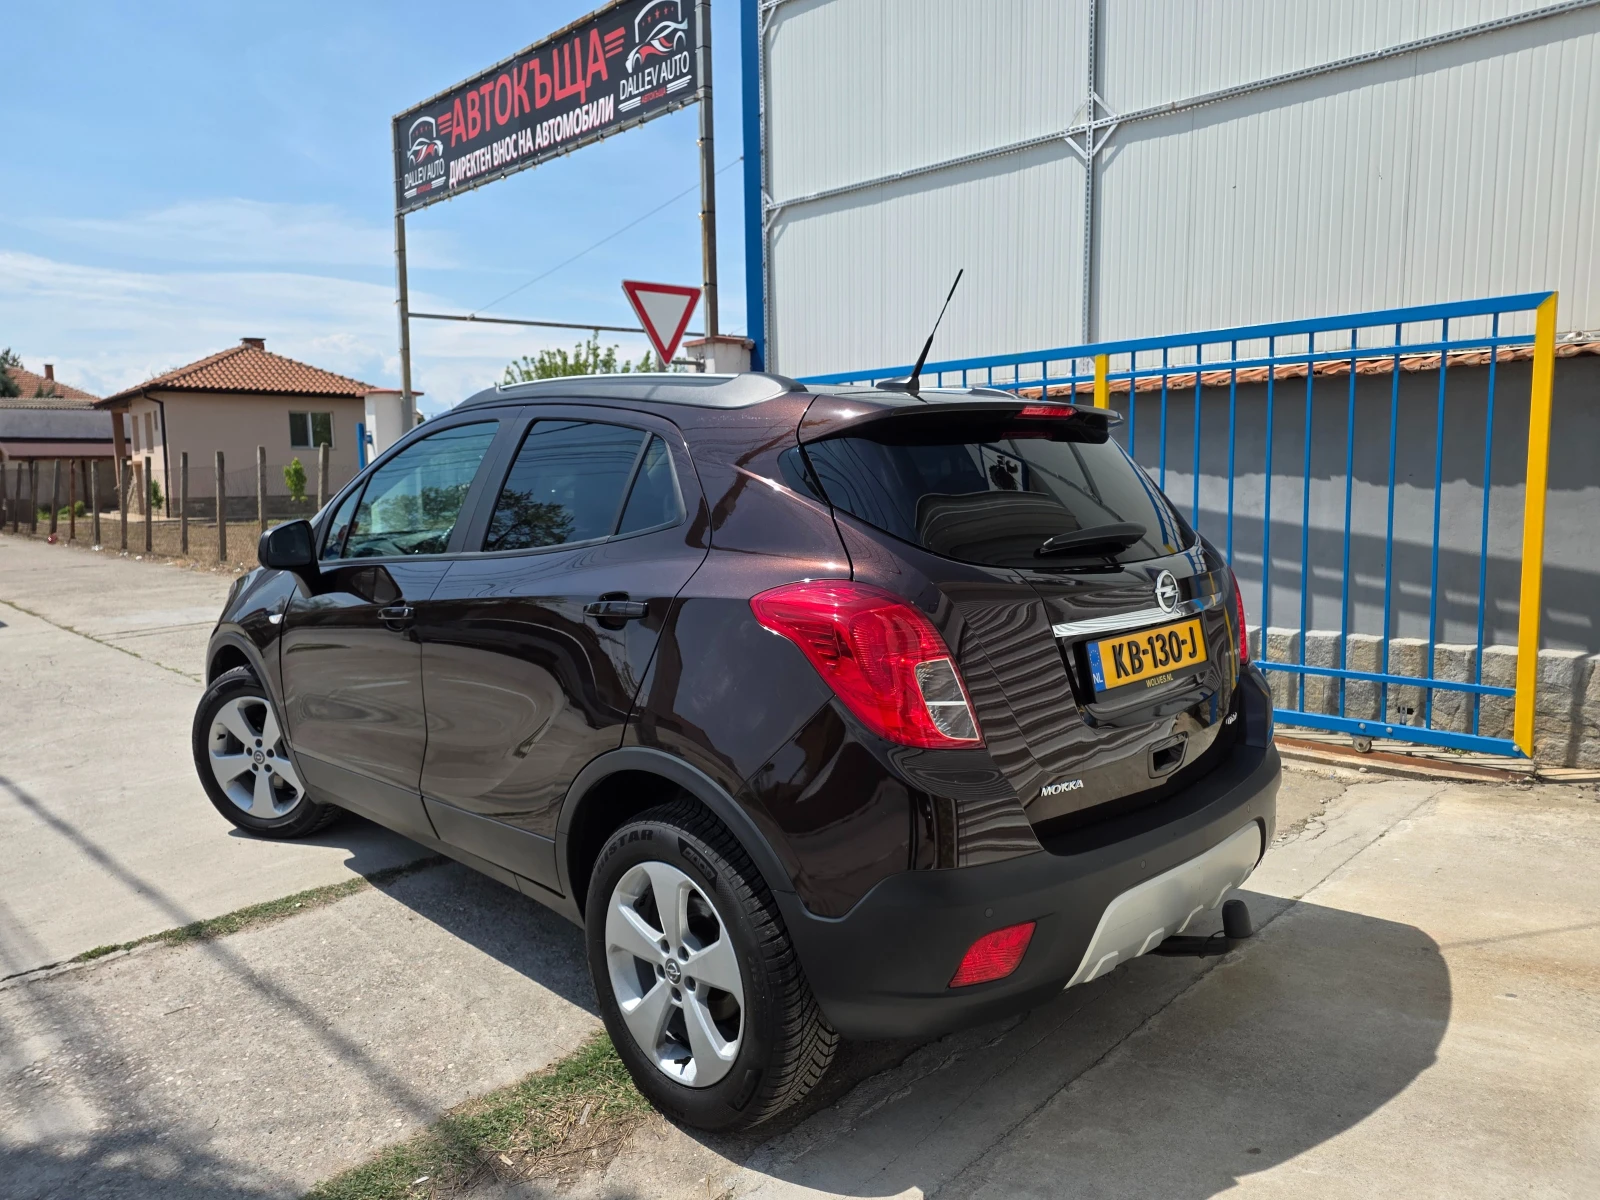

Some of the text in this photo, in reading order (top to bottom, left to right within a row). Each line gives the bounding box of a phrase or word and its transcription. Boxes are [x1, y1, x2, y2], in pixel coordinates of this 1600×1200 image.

[450, 27, 609, 148] АВТОКЪЩА
[619, 51, 690, 101] DALLEV AUTO
[449, 93, 615, 189] ДИРЕКТЕН ВНОС НА АВТОМОБИЛИ
[404, 165, 427, 190] DALLEV
[426, 157, 446, 181] AUTO
[1111, 626, 1198, 680] KB-130-J
[1092, 672, 1104, 685] NL
[1145, 673, 1175, 688] WOLVES.NL
[1040, 779, 1085, 798] MOKKA
